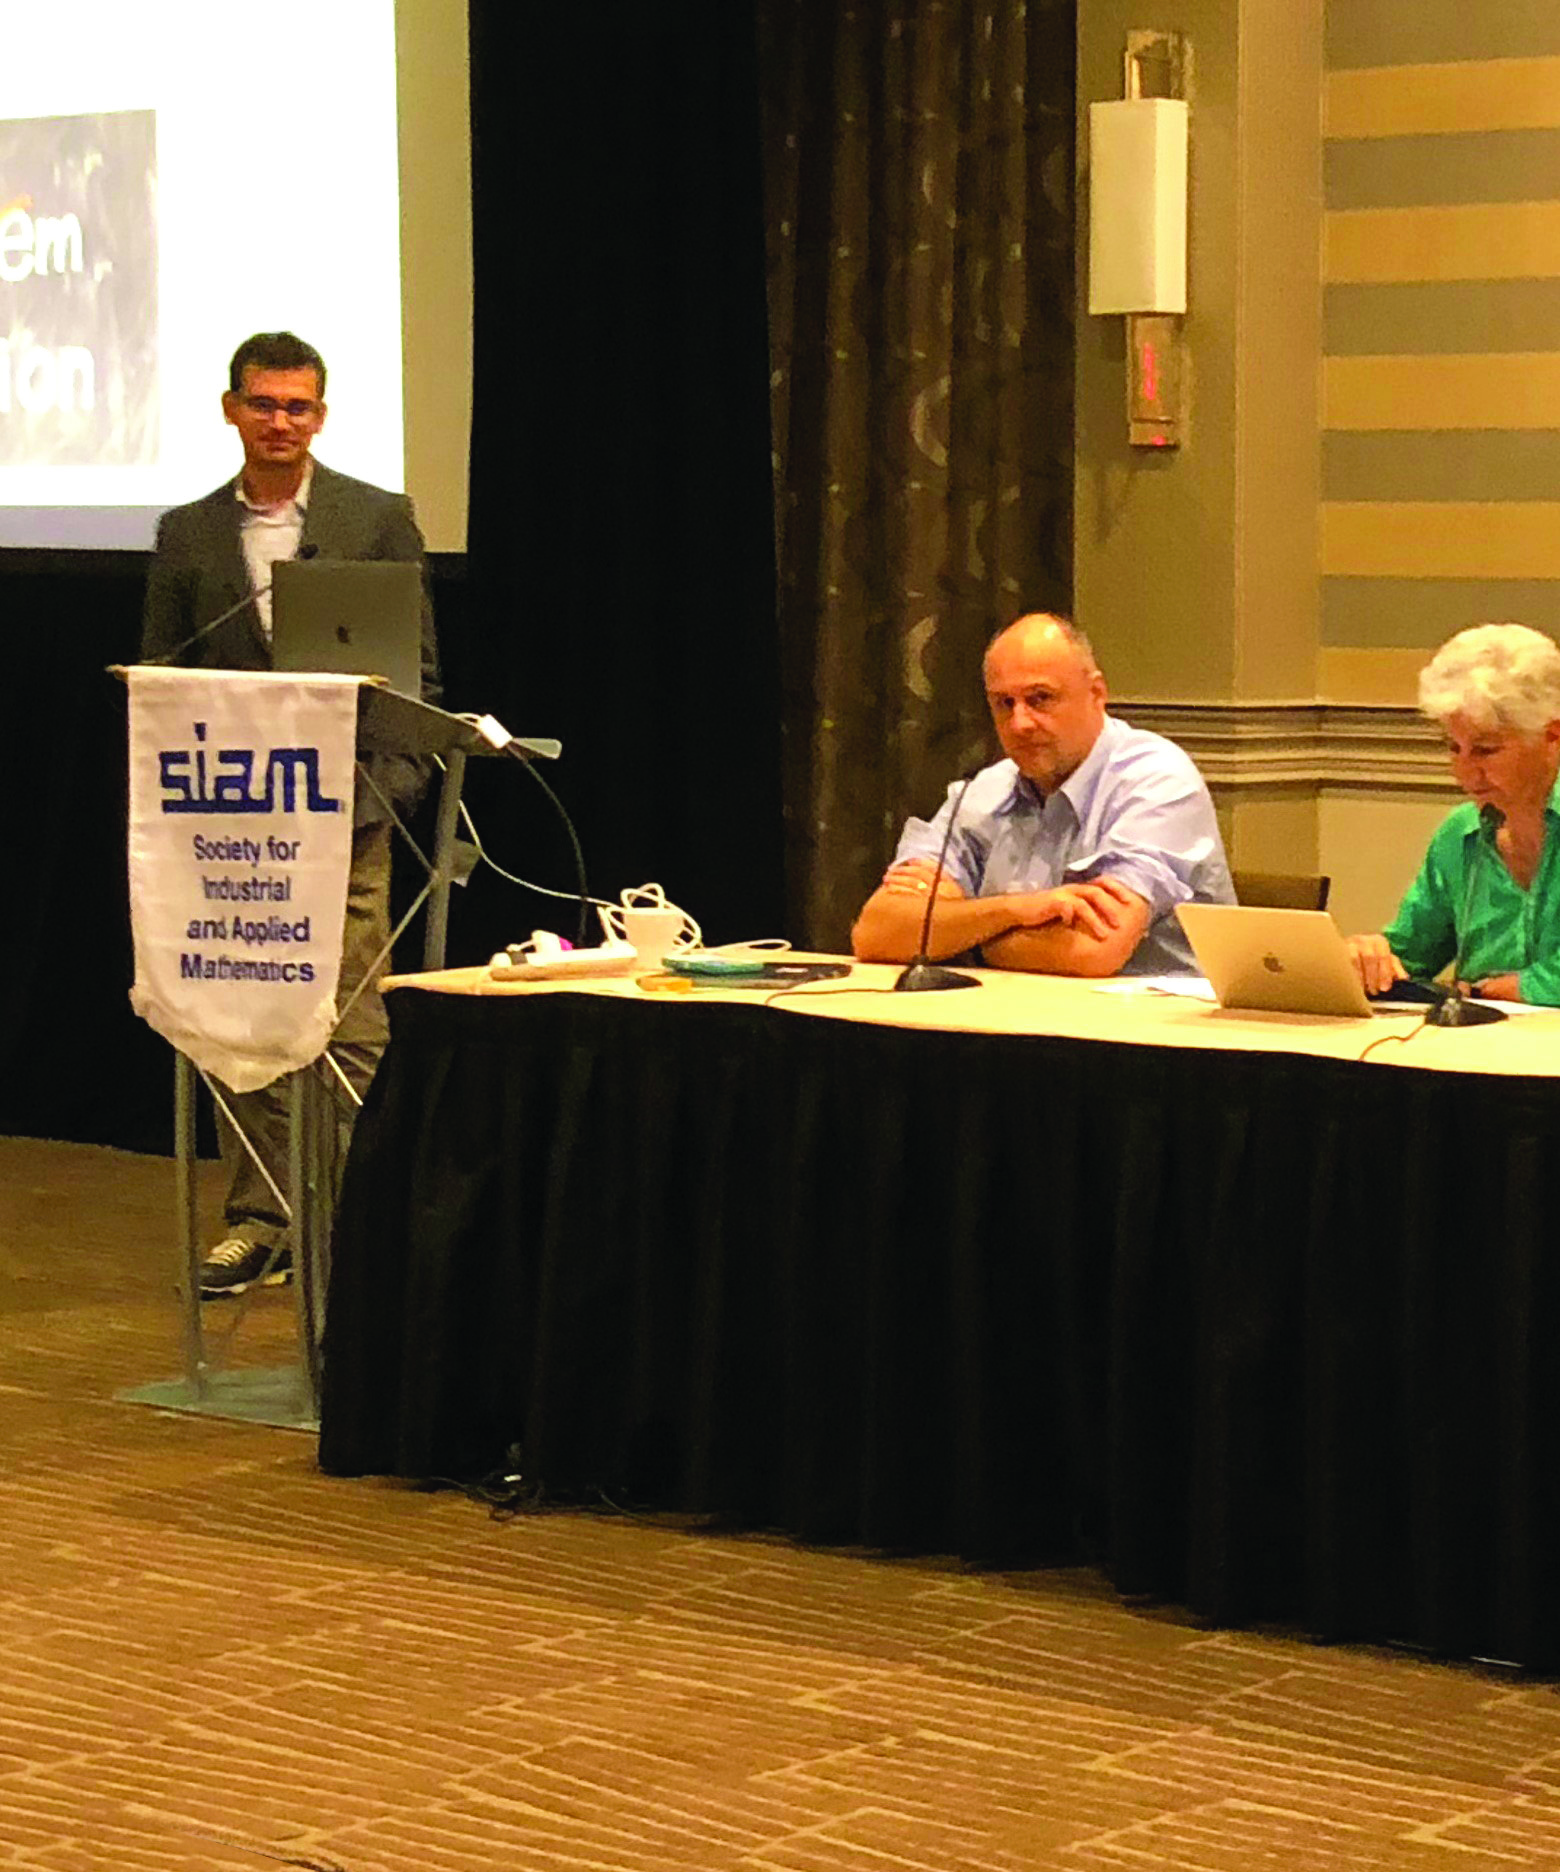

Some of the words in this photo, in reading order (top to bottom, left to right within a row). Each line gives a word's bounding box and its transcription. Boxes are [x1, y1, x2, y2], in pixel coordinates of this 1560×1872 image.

[193, 833, 261, 867] Society
[266, 834, 301, 861] for
[202, 875, 292, 901] Industrial
[186, 917, 227, 940] and
[232, 915, 310, 946] Applied
[180, 953, 315, 982] Mathematics
